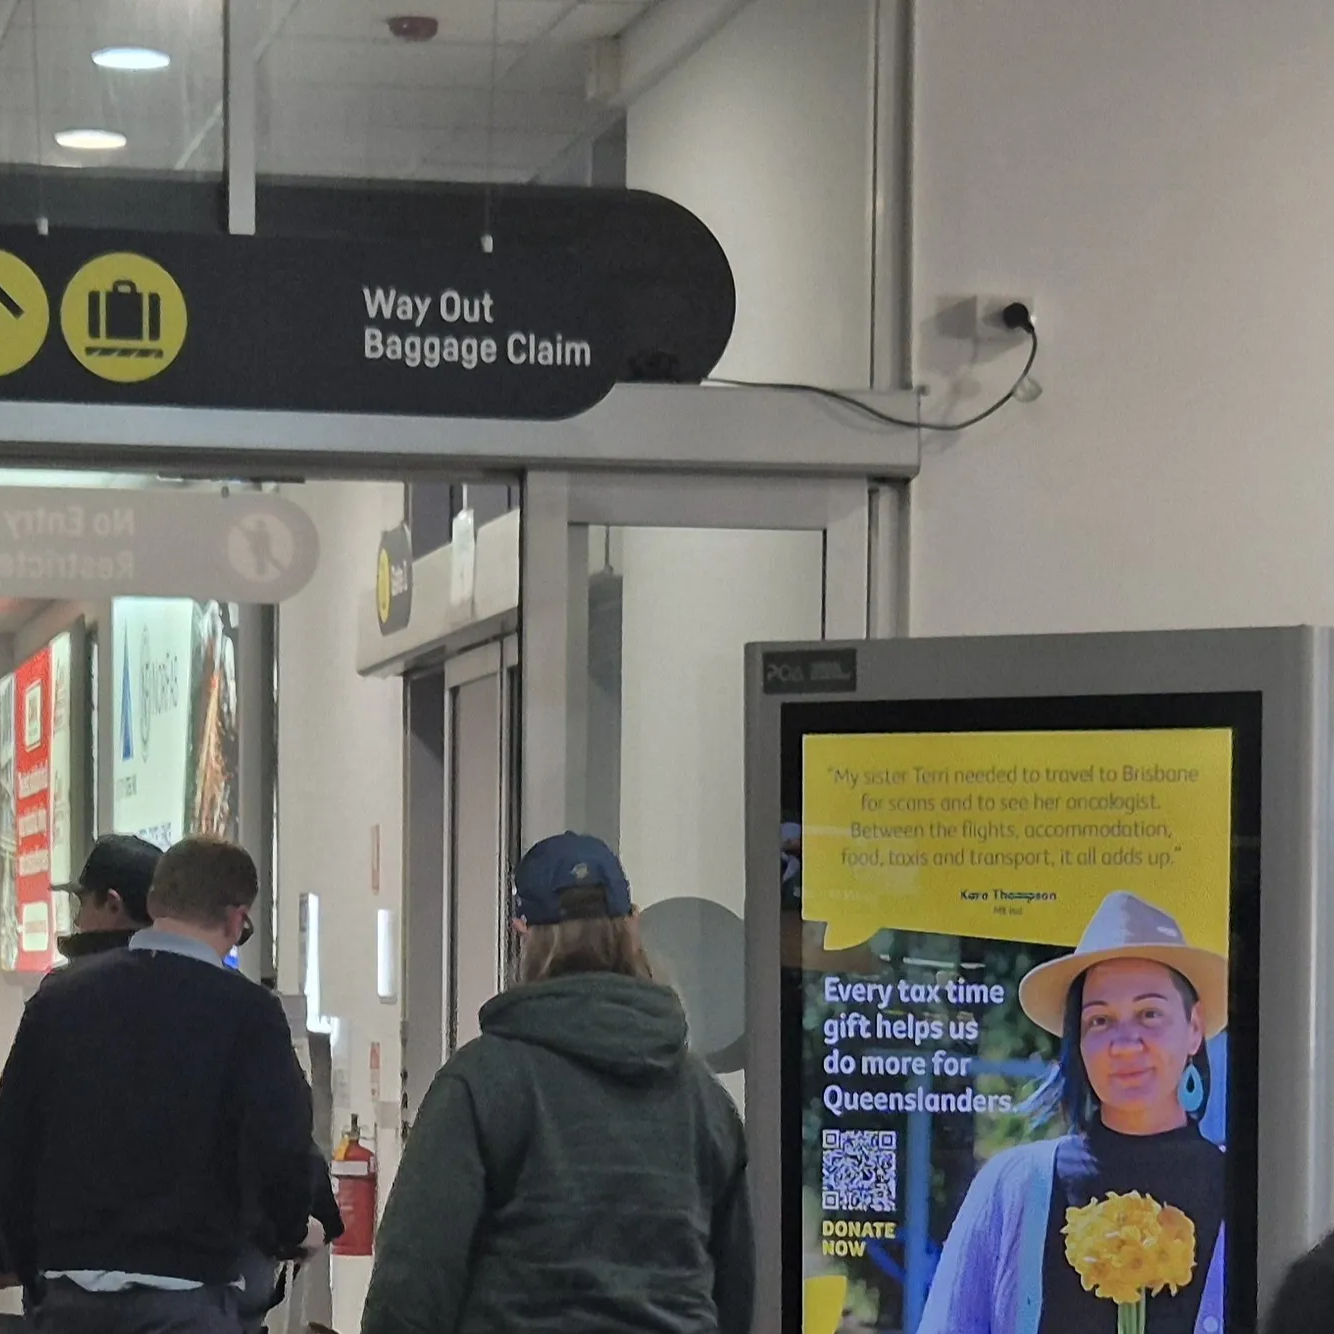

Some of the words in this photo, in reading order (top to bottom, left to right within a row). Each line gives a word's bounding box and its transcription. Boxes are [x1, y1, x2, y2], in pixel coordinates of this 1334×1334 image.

[362, 285, 432, 328] Way
[439, 288, 495, 324] Out
[363, 327, 498, 370] Baggage
[506, 331, 592, 367] Claim
[863, 768, 907, 785] sister
[913, 766, 949, 784] Terri
[954, 766, 1017, 784] needed
[1022, 768, 1040, 783] to
[1045, 765, 1094, 783] travel
[1099, 767, 1118, 783] to
[1123, 764, 1200, 783] Brisbane
[860, 793, 884, 812] for
[889, 798, 935, 811] scans
[940, 794, 972, 811] and
[978, 796, 996, 811] to
[1000, 797, 1030, 811] see
[1034, 793, 1062, 811] her
[1066, 792, 1161, 814] oncologist.
[850, 822, 925, 839] Between
[929, 822, 957, 838] the
[962, 820, 1019, 844] flights,
[1024, 820, 1173, 839] accommodation,
[841, 848, 884, 867] food,
[889, 849, 928, 866] taxis
[933, 848, 964, 866] and
[970, 849, 1055, 870] transport,
[1060, 848, 1073, 866] it
[1076, 847, 1097, 866] all
[1101, 848, 1143, 866] adds
[823, 976, 893, 1009] Every
[896, 978, 942, 1004] tax
[944, 977, 1005, 1004] time
[823, 1012, 872, 1045] gift
[875, 1013, 944, 1046] helps
[949, 1020, 979, 1040] us
[823, 1048, 857, 1075] do
[861, 1054, 927, 1076] more
[931, 1049, 973, 1076] for
[822, 1084, 1017, 1117] Queenslanders.
[822, 1220, 897, 1239] DONATE
[822, 1239, 867, 1258] NOW
